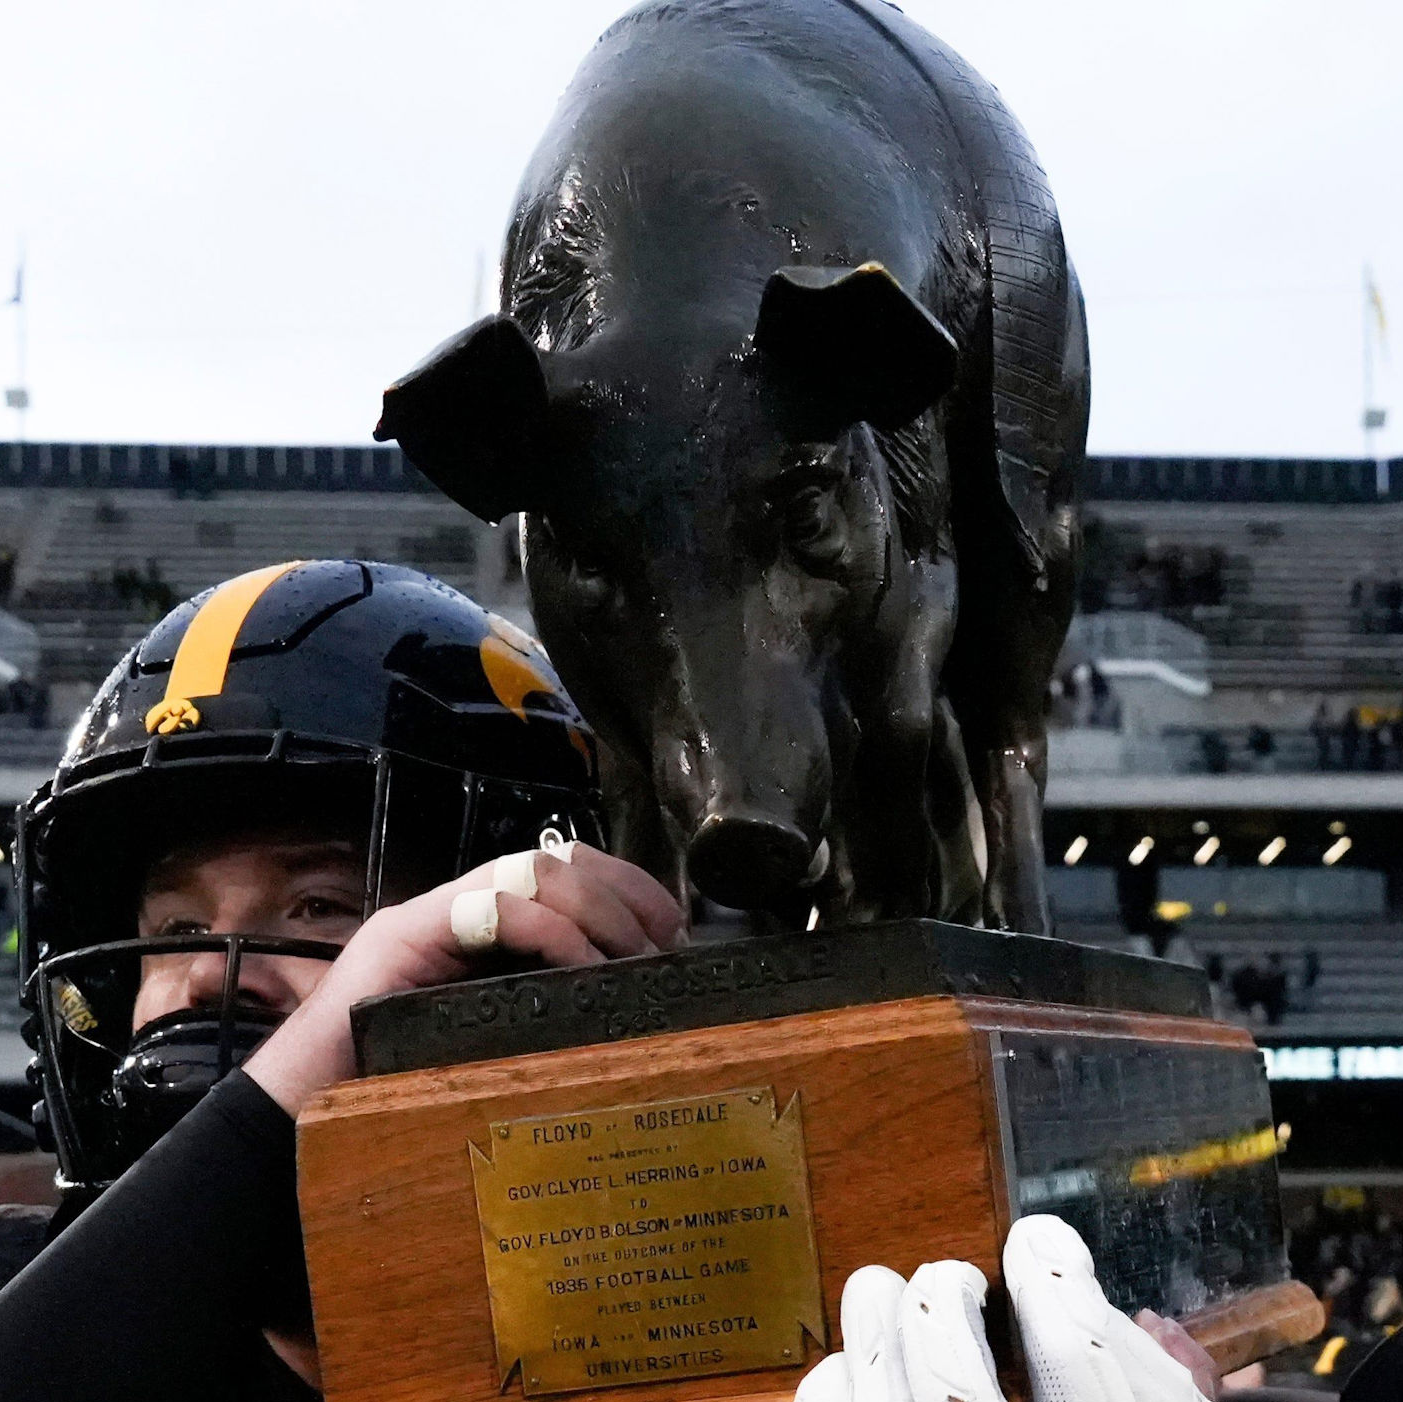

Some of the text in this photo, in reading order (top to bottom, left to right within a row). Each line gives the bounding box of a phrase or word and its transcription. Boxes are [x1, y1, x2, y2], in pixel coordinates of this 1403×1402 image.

[533, 1122, 592, 1144] FLOYD
[635, 1104, 728, 1130] ROSEDALE
[548, 1177, 602, 1195] CLYDE
[720, 1156, 767, 1174] IOWA
[630, 1199, 647, 1209] TO
[540, 1228, 595, 1245] FLOYD
[685, 1204, 789, 1229] MINNESOTA
[564, 1238, 726, 1267] ON THE OUTCOME OF THE
[547, 1259, 750, 1296] 1935 FOOTBALL GAME
[598, 1294, 706, 1316] PLAYED BETWEEN
[552, 1337, 600, 1352] IOWA
[649, 1317, 758, 1341] MINNESOTA
[587, 1350, 724, 1378] UNIVERSITIES
